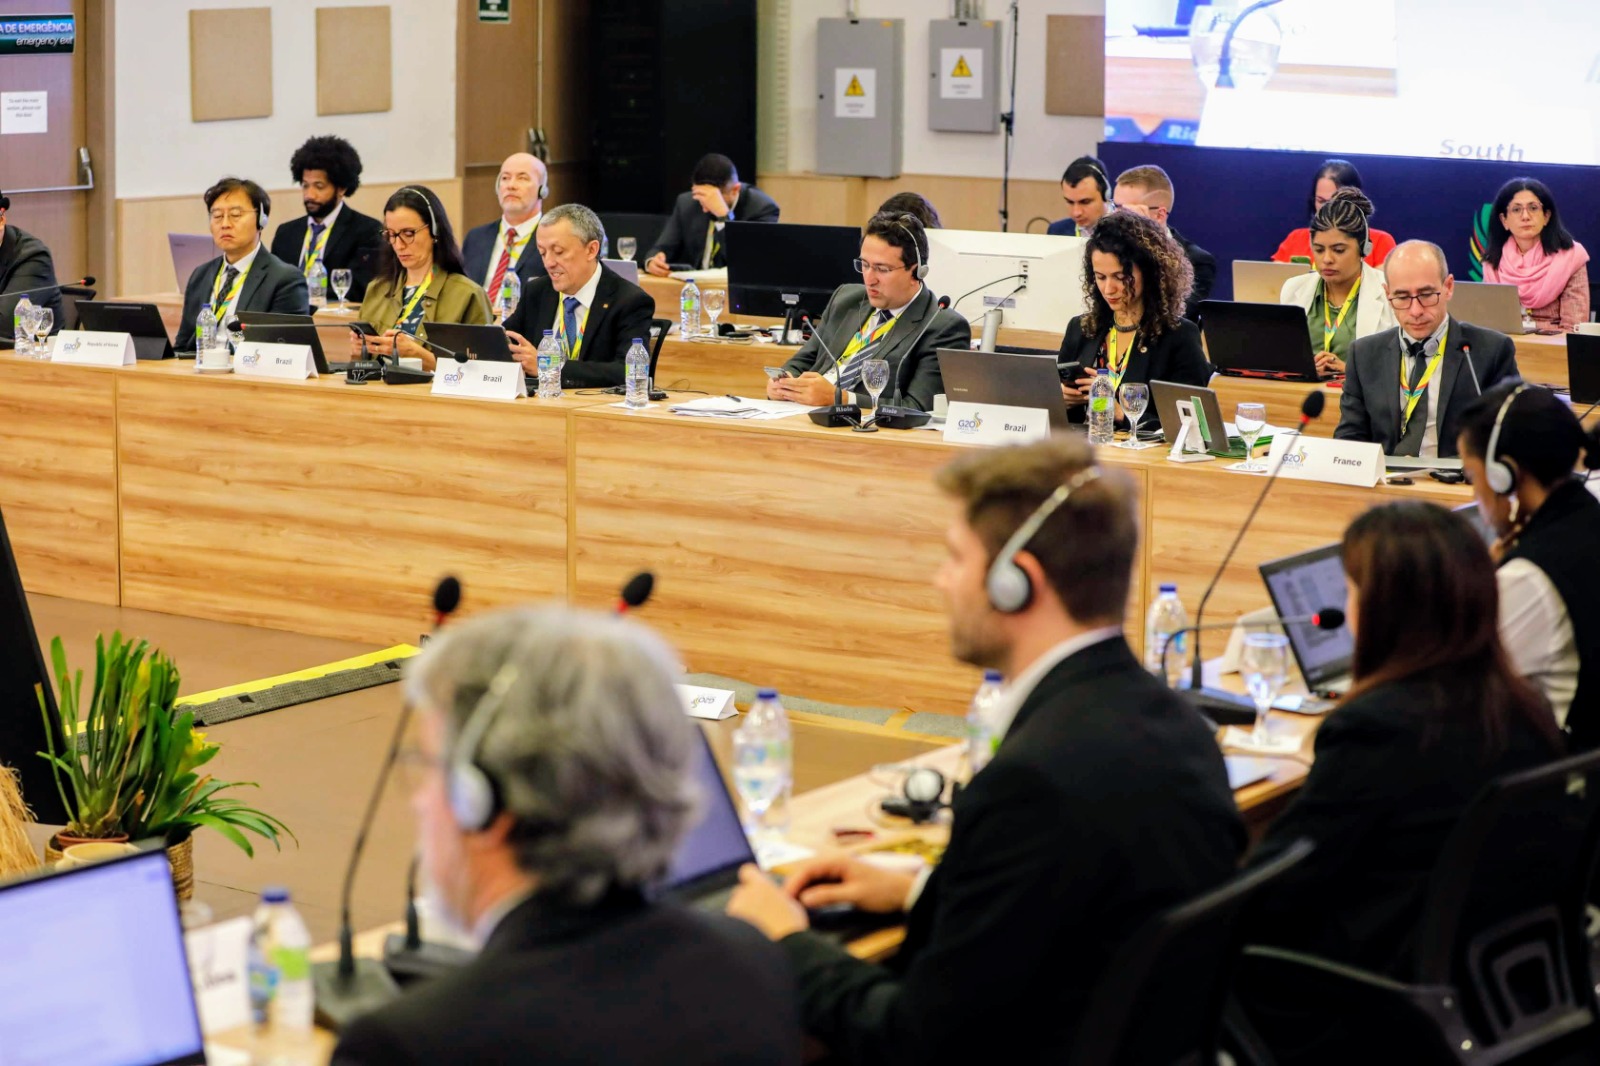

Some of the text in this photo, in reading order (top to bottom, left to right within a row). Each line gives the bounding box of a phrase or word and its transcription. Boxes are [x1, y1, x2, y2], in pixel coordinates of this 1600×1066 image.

[5, 23, 17, 32] DE
[19, 20, 73, 32] EMERGÊNCIA
[16, 37, 58, 47] emergency
[1440, 139, 1524, 162] South
[243, 355, 256, 363] G20
[275, 357, 293, 365] Brazil
[444, 373, 458, 382] G20
[483, 374, 503, 383] Brazil
[958, 419, 976, 429] G20
[1004, 423, 1027, 432] Brazil
[1282, 453, 1301, 463] G20
[1332, 456, 1362, 467] France
